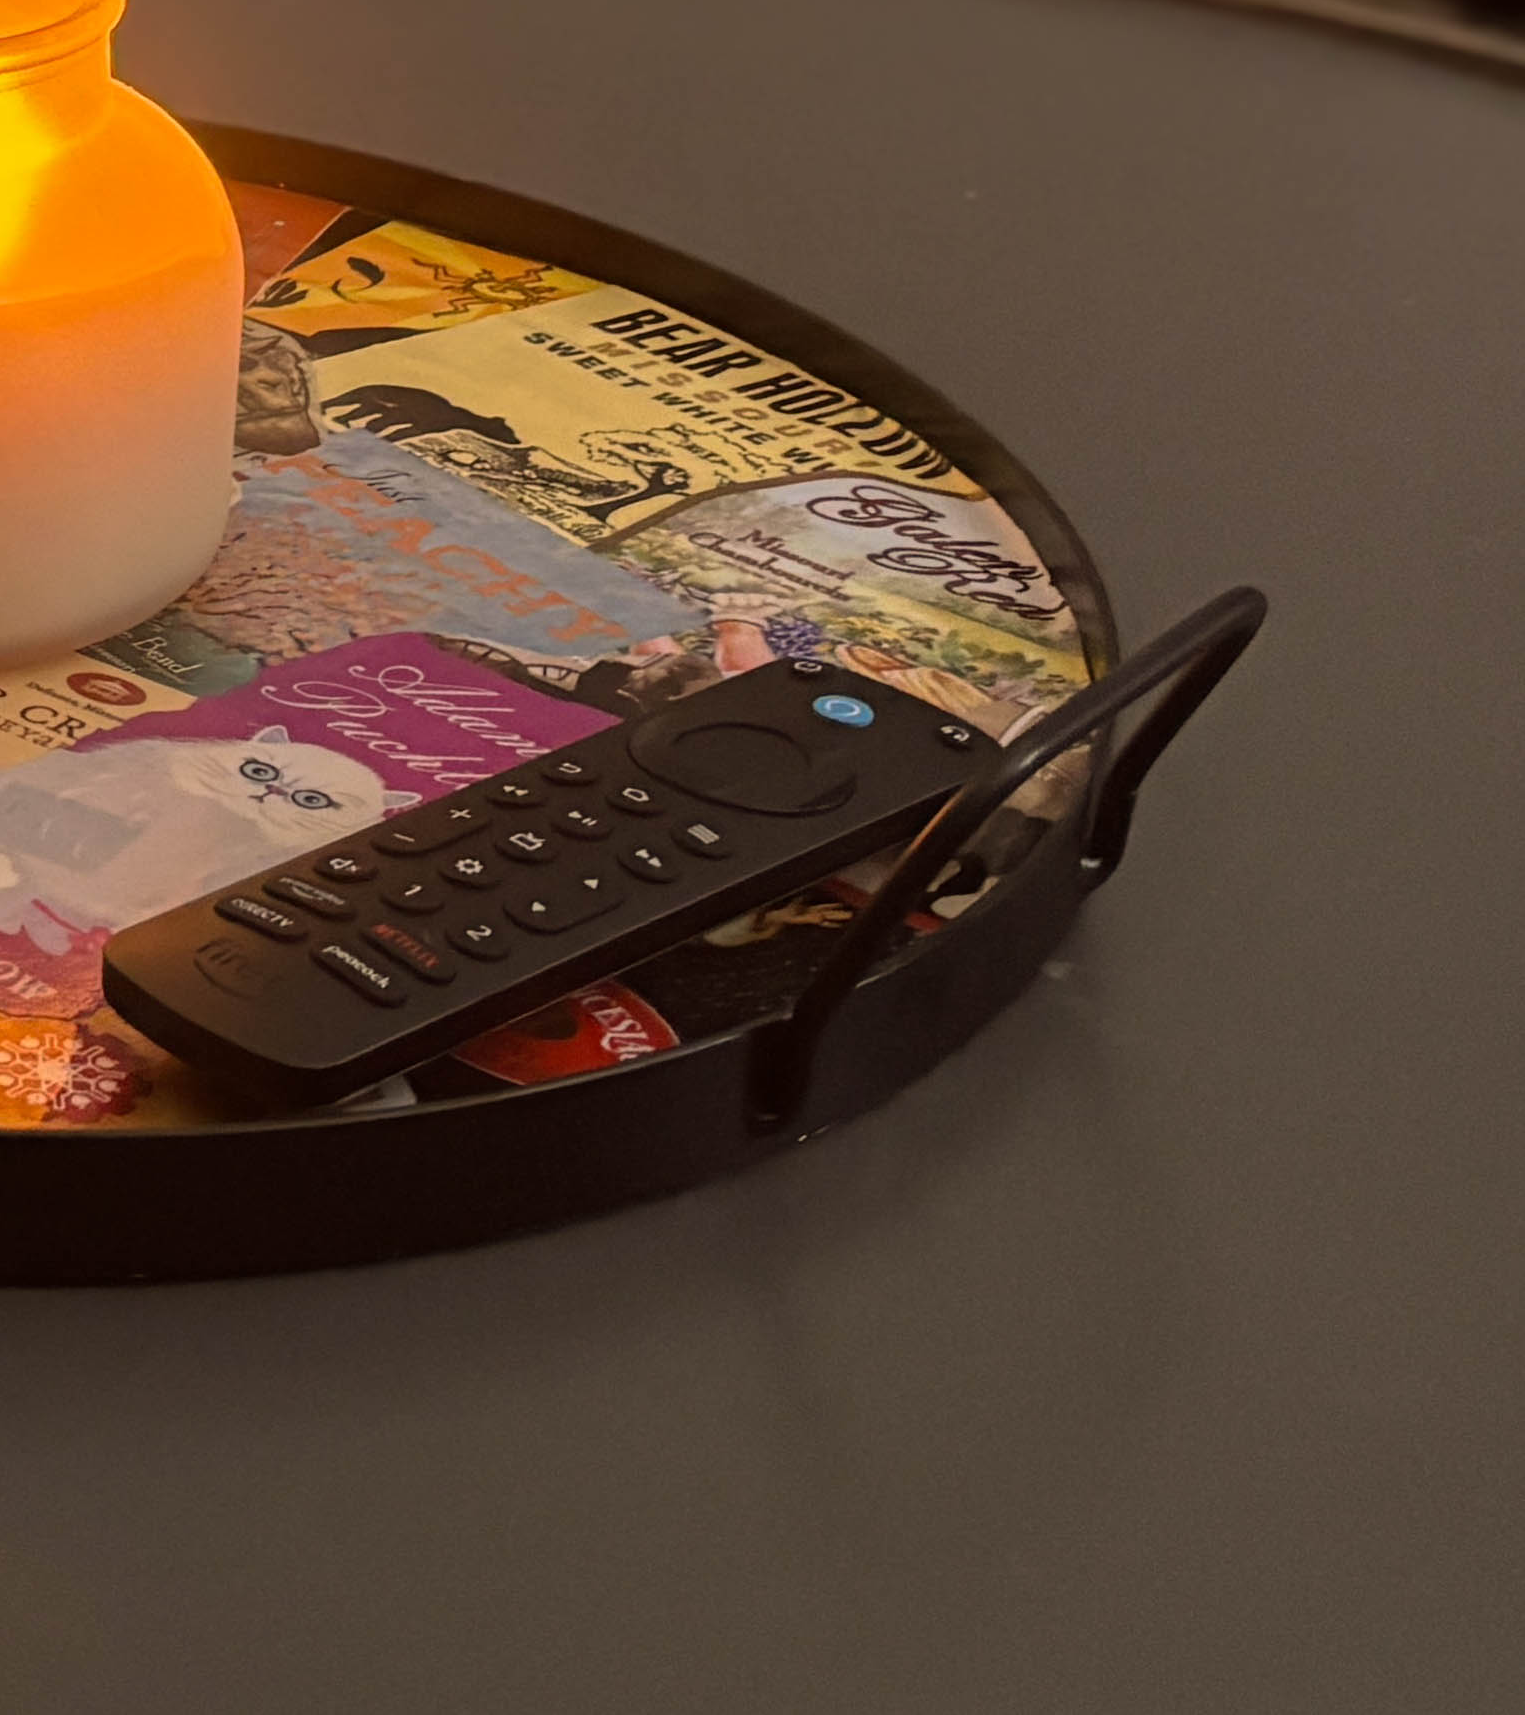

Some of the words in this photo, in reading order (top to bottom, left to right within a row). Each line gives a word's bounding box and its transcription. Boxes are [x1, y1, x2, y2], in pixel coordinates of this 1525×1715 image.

[590, 308, 761, 379] BEAR
[524, 332, 650, 389] SWEET
[651, 391, 780, 447] WHITE
[263, 455, 631, 643] PEACHY
[133, 635, 207, 675] Bend
[403, 884, 424, 898] 1
[230, 897, 296, 929] DIRECTV
[465, 925, 494, 943] 2
[321, 944, 392, 991] peacock
